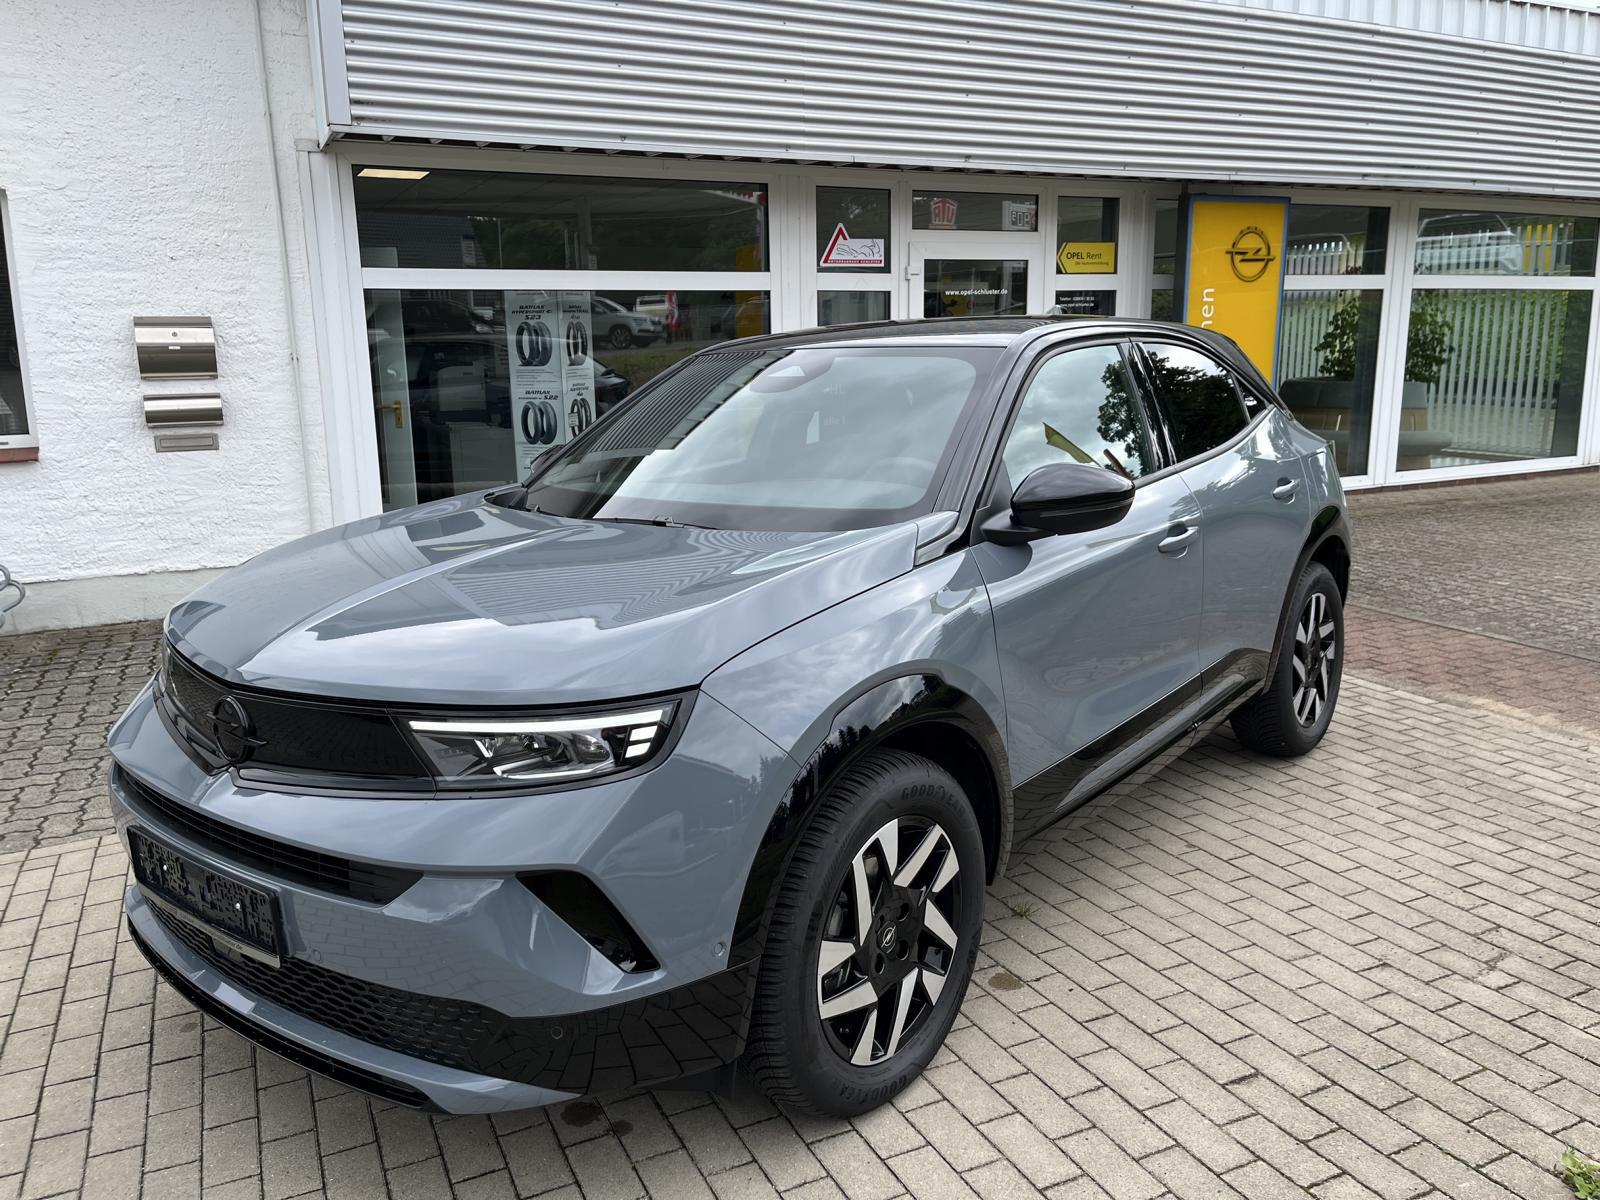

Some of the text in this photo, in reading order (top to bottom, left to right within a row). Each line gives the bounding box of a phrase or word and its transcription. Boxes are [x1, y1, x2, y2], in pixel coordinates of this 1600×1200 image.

[1066, 251, 1102, 260] OPEL Rent
[945, 288, 1008, 297] www.opel-schlueter.de
